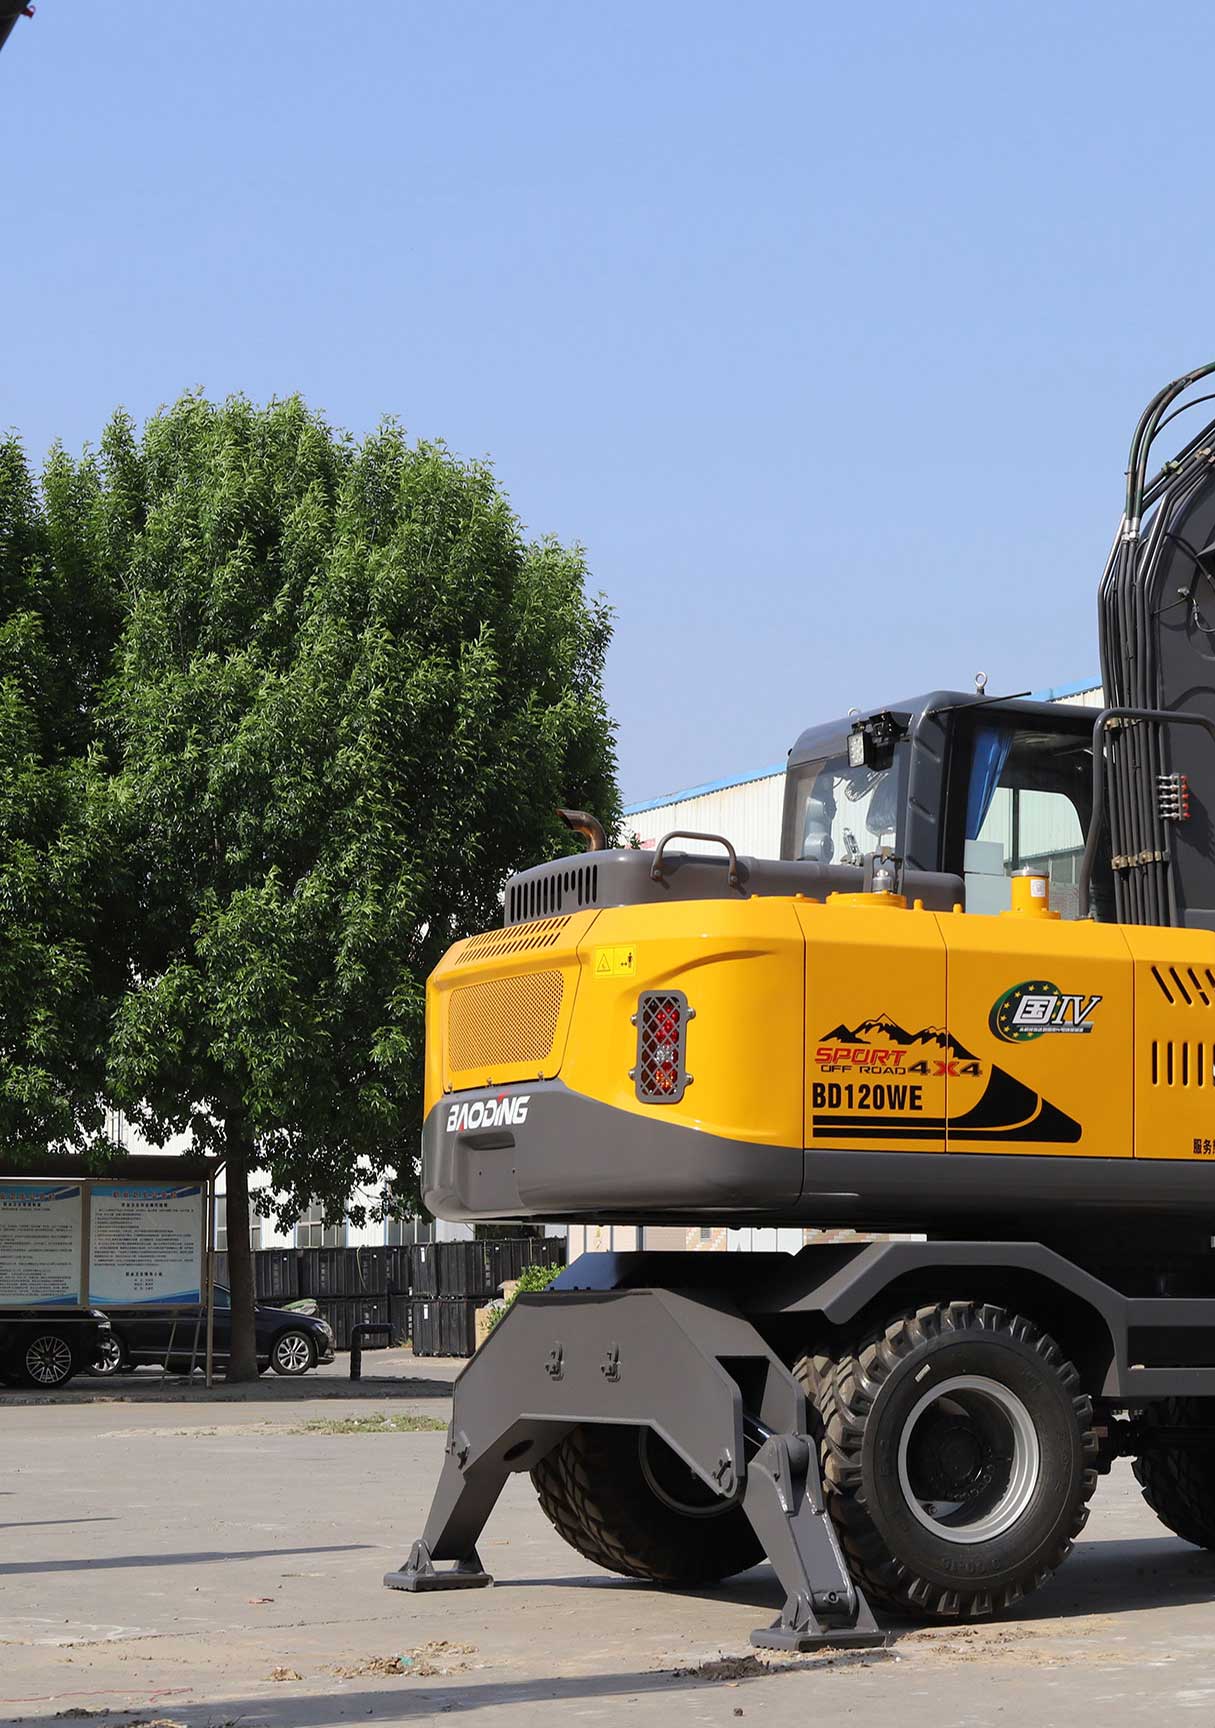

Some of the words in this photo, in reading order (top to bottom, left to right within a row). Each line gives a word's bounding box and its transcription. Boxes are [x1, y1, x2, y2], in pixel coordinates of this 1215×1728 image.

[814, 1047, 907, 1066] SPORT
[820, 1064, 852, 1073] OFF
[859, 1065, 907, 1076] ROAD
[812, 1082, 923, 1111] BD120WE
[446, 1088, 531, 1133] BAODING
